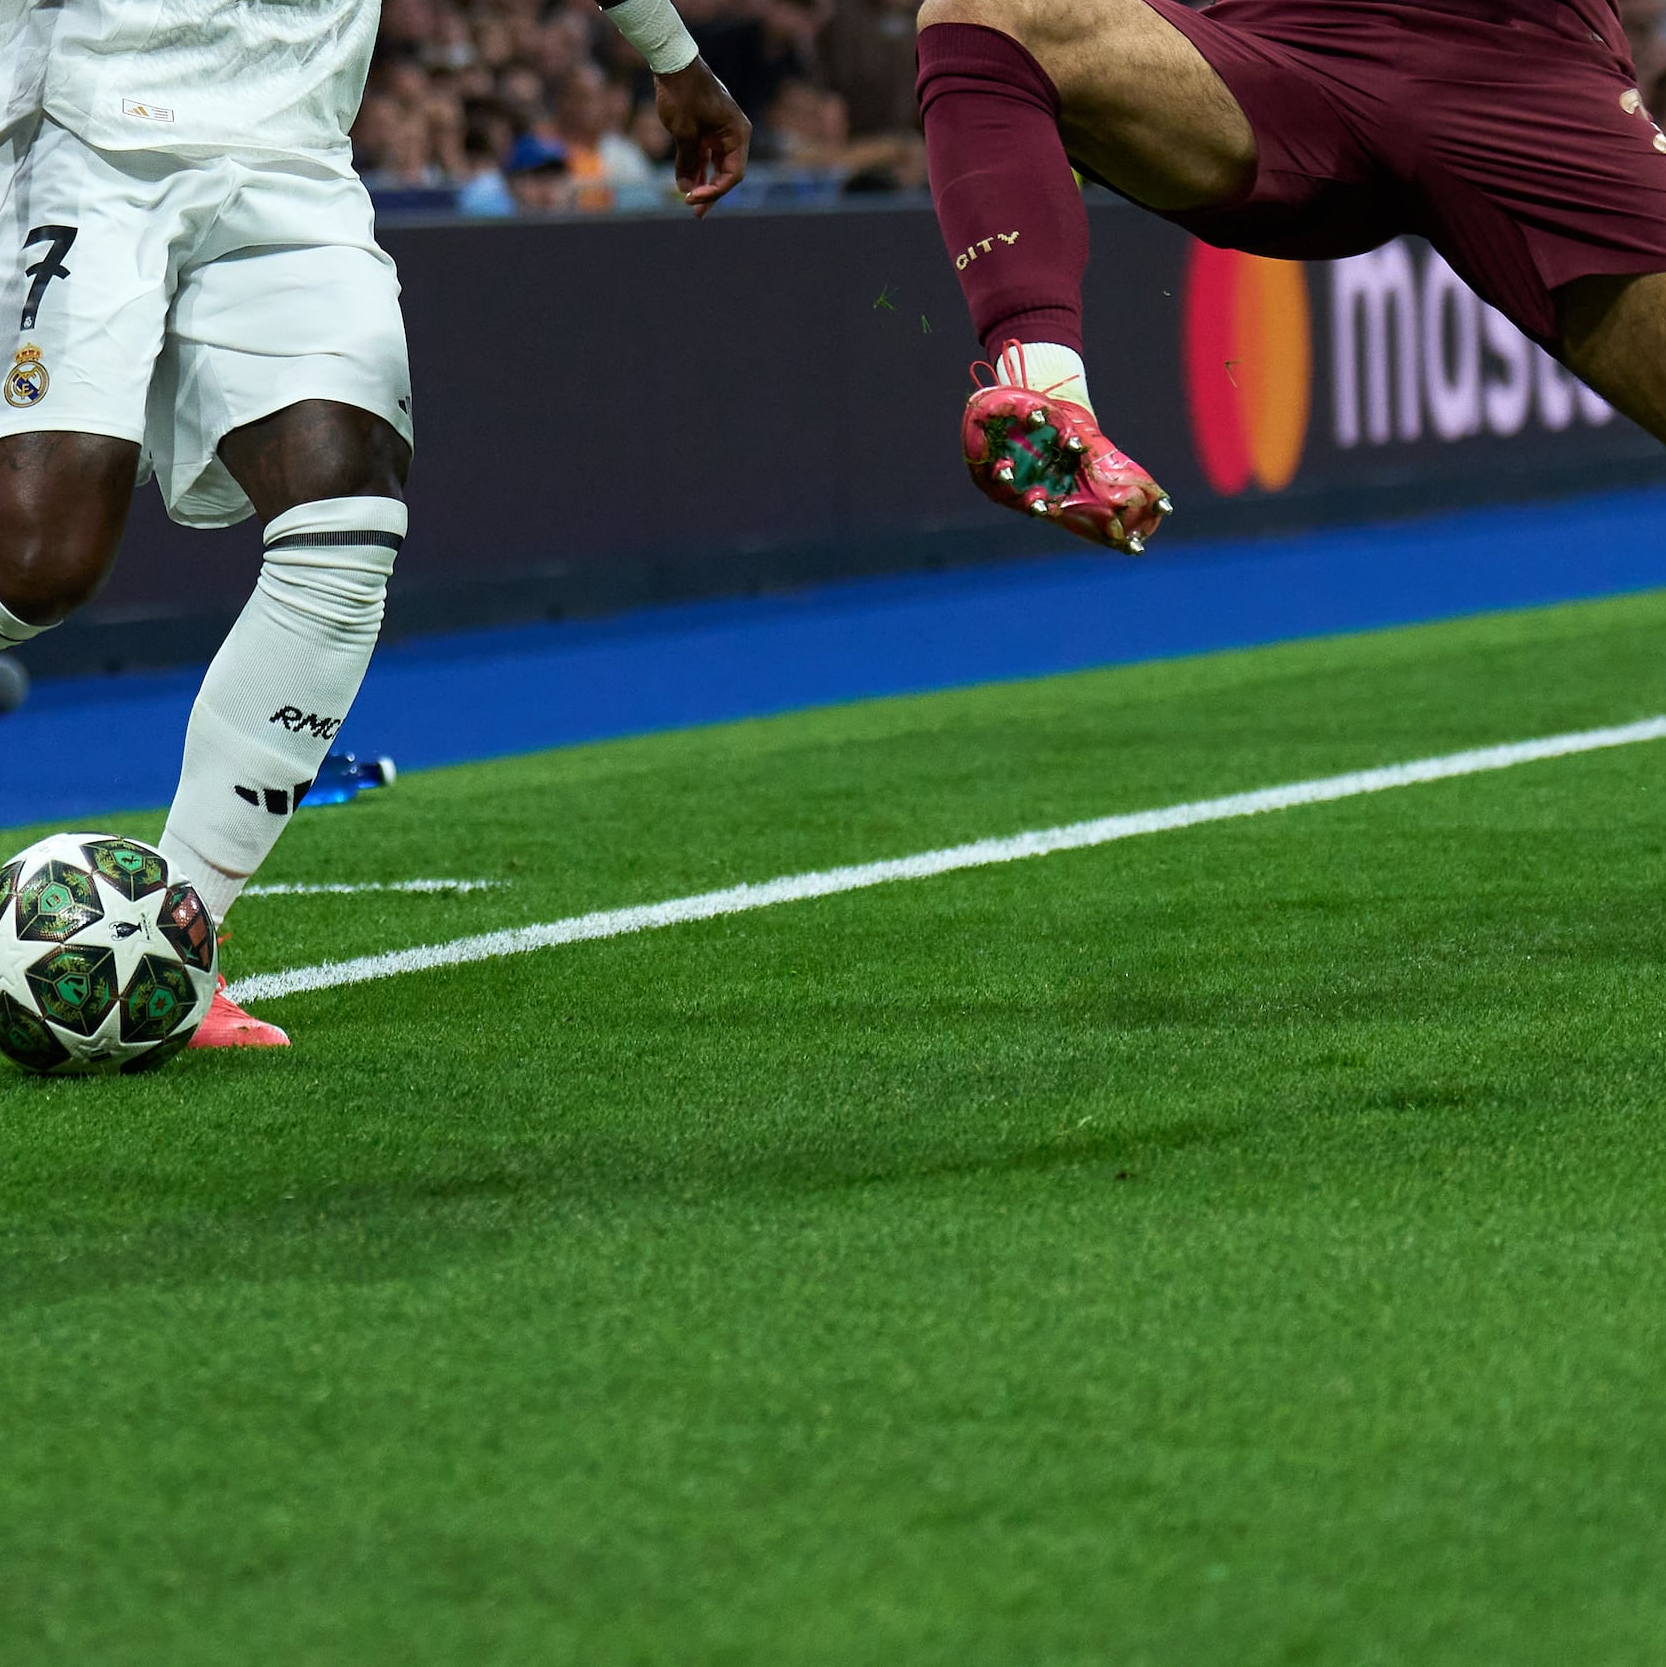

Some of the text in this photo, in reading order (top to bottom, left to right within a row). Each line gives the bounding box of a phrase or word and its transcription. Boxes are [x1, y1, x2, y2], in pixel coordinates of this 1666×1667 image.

[956, 231, 1020, 271] CITY
[21, 225, 79, 331] 7
[269, 704, 342, 740] RMC
